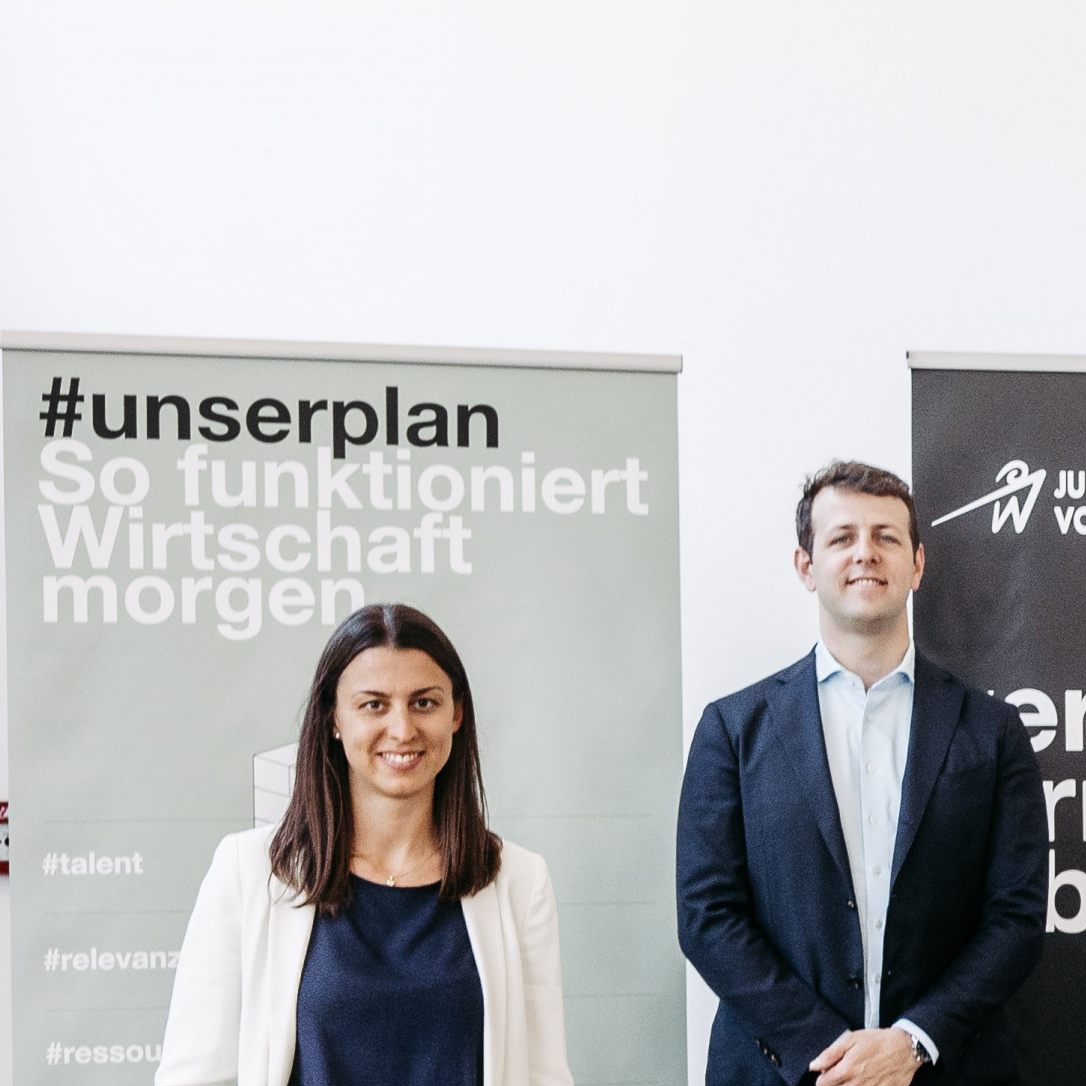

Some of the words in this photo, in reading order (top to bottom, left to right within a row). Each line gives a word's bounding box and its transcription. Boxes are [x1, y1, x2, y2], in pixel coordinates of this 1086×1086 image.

[38, 375, 500, 459] #unserplan
[38, 438, 150, 507] So
[177, 444, 649, 516] funktioniert
[37, 503, 472, 576] Wirtschaft
[42, 573, 365, 641] morgen
[42, 851, 144, 877] #talent
[43, 947, 181, 972] #relevanz
[46, 1041, 162, 1066] #ressou
